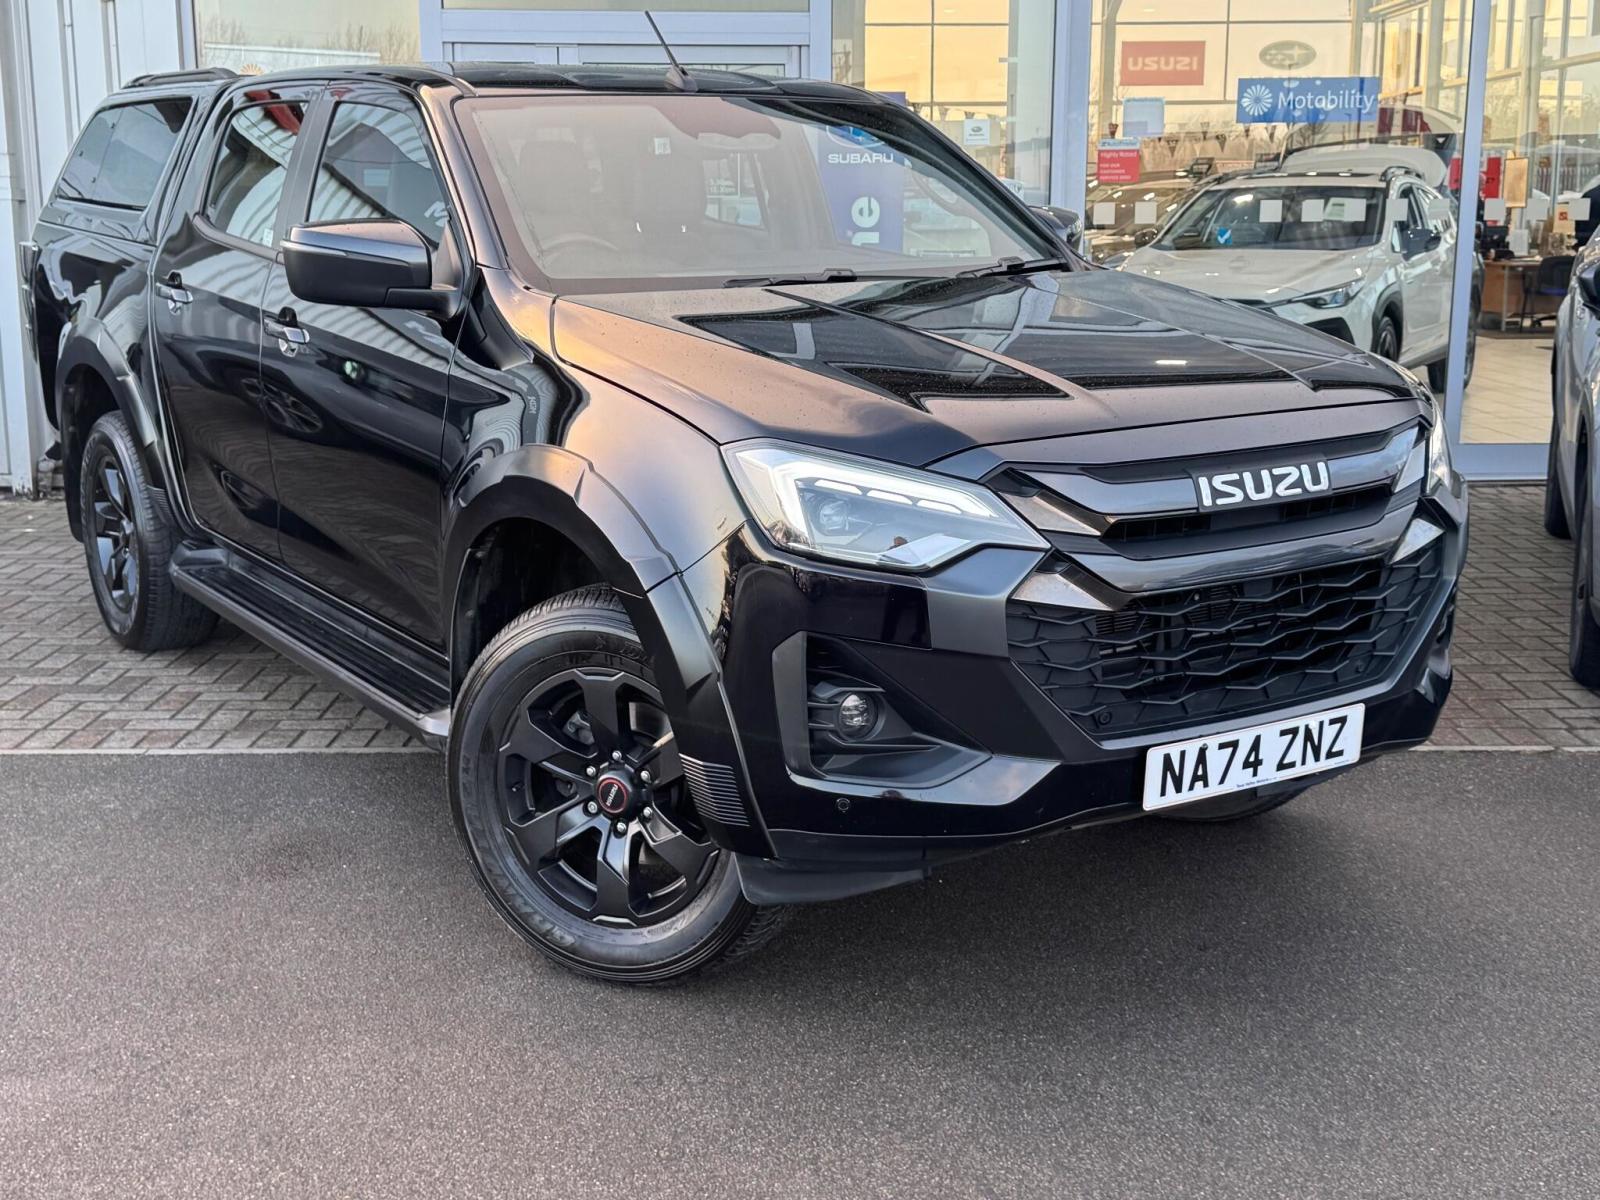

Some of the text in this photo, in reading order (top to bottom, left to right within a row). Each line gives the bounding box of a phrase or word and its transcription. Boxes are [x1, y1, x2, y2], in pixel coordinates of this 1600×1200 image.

[1278, 89, 1374, 114] Motability
[828, 153, 894, 164] SUBARU
[1198, 461, 1329, 507] ISUZU
[1160, 715, 1348, 797] NA74 ZNZ
